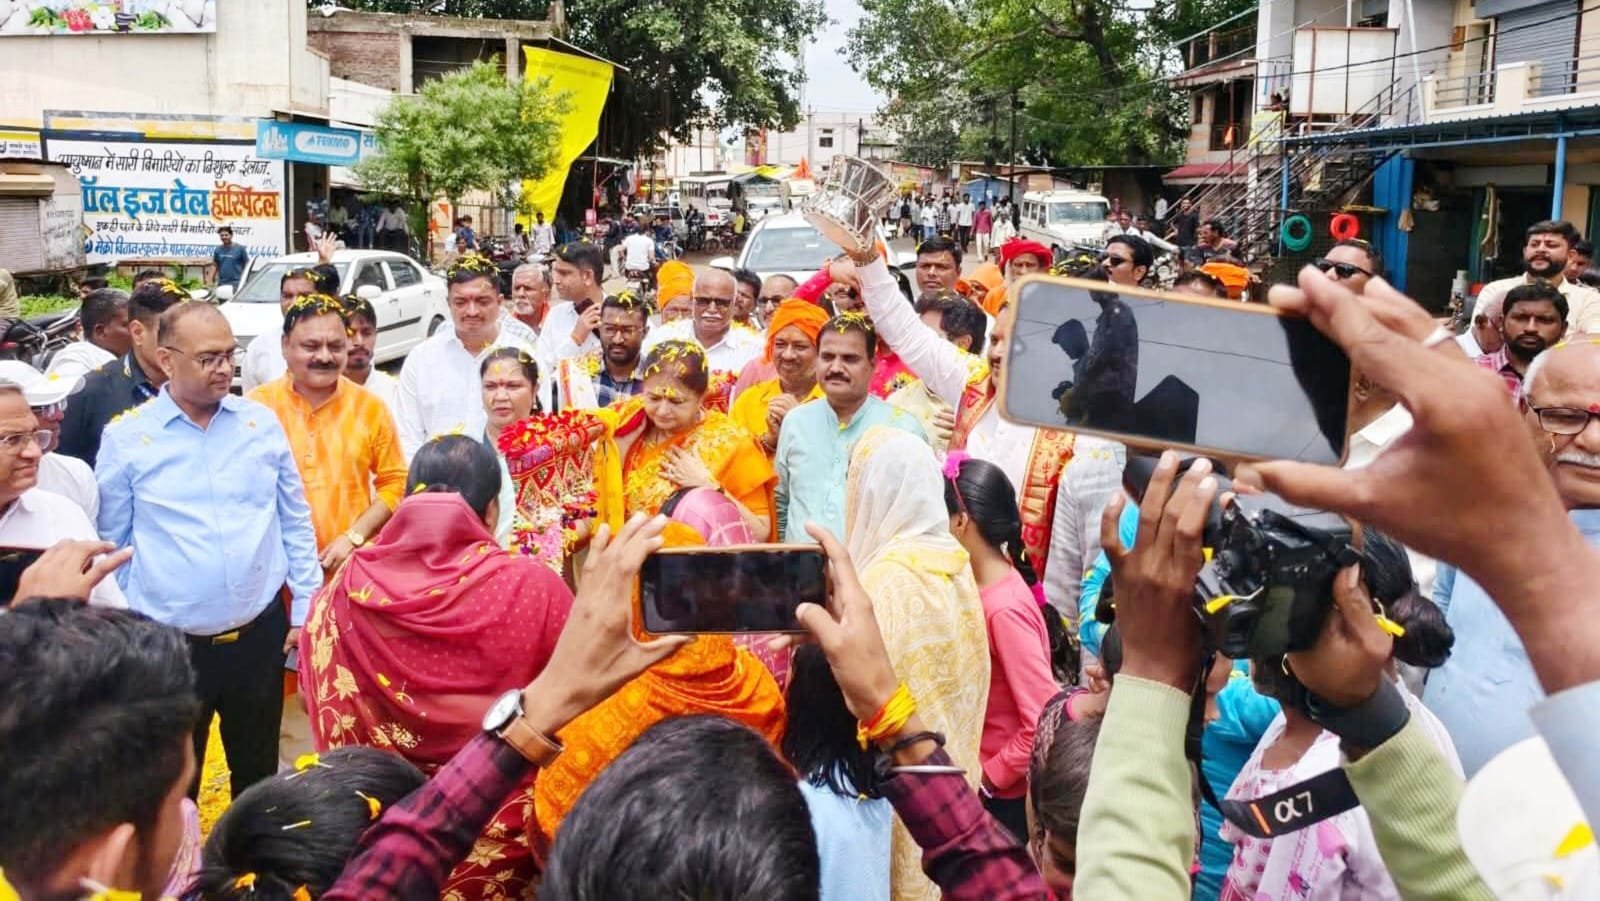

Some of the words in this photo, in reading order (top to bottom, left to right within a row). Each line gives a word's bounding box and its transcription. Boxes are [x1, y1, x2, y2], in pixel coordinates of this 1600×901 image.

[123, 187, 167, 219] इज
[169, 178, 210, 215] वेल
[211, 180, 279, 221] हॉस्पिटल
